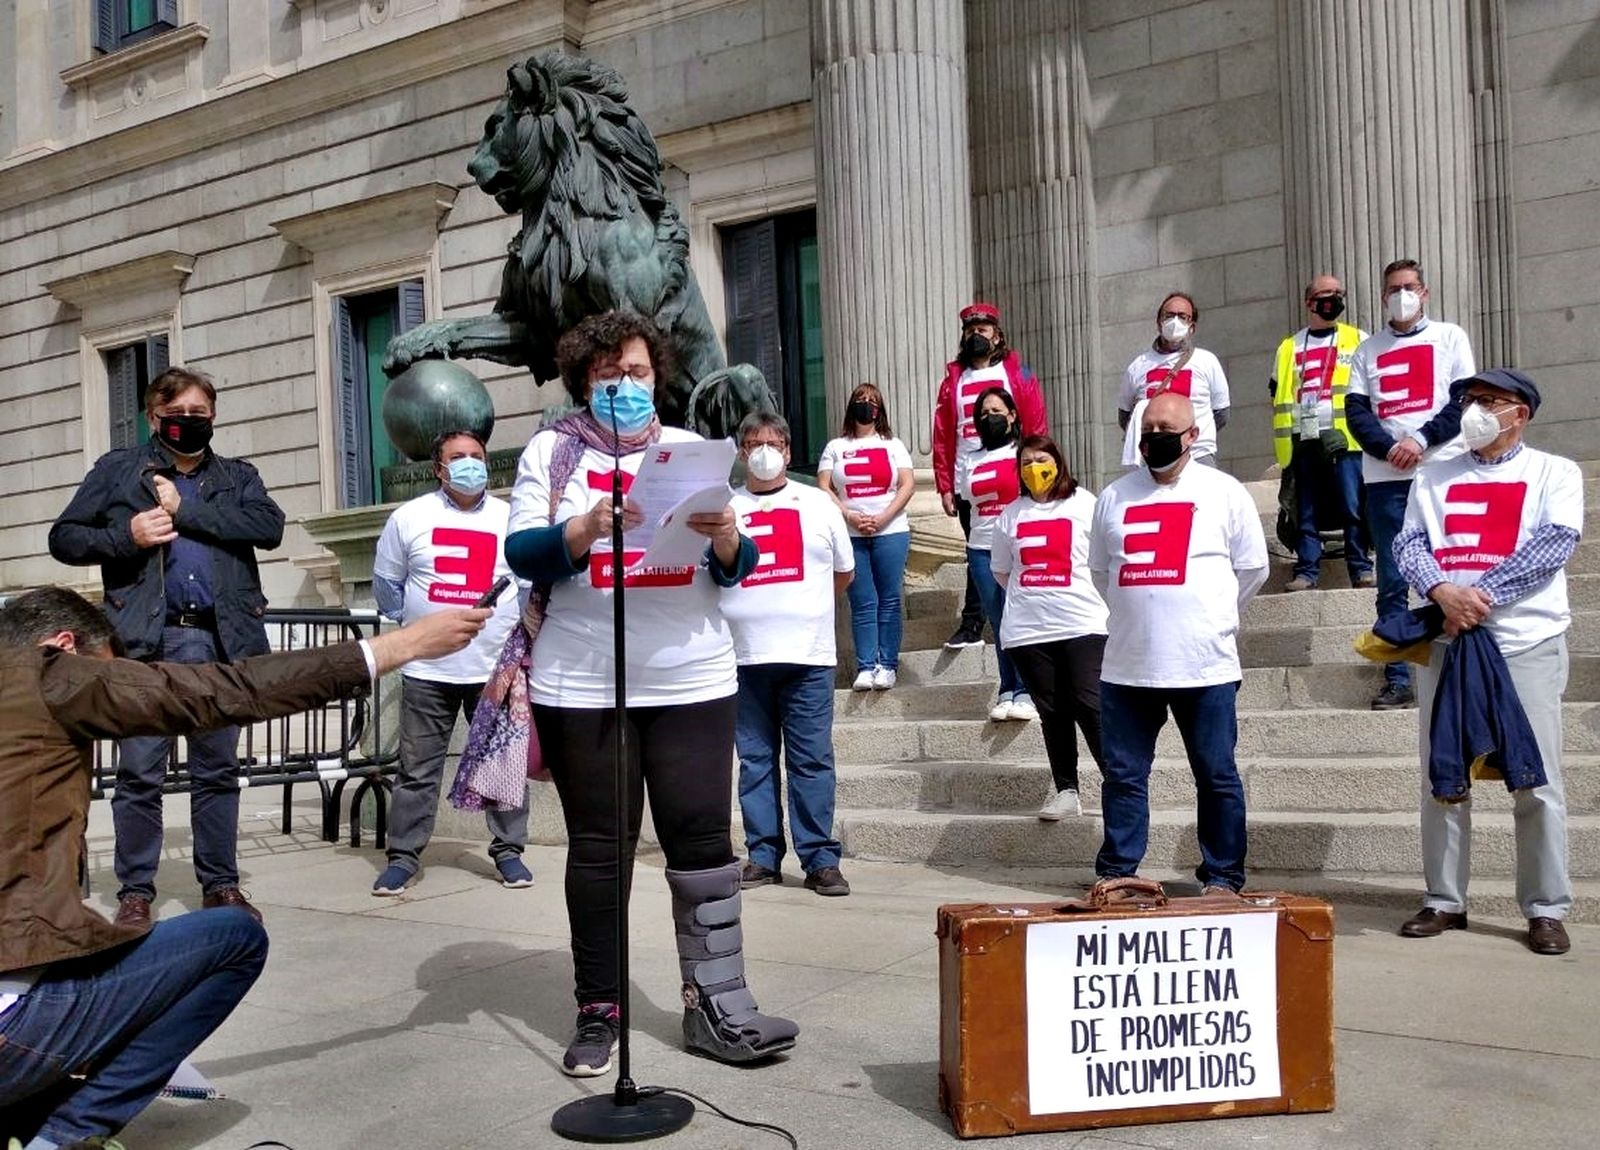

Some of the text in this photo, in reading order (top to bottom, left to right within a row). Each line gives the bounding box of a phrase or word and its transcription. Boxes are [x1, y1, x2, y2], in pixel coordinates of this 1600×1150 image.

[1118, 927, 1233, 965] MALETA
[1073, 968, 1239, 1010] ESTÁ LLENA
[1071, 1010, 1252, 1054] DE PROMESAS
